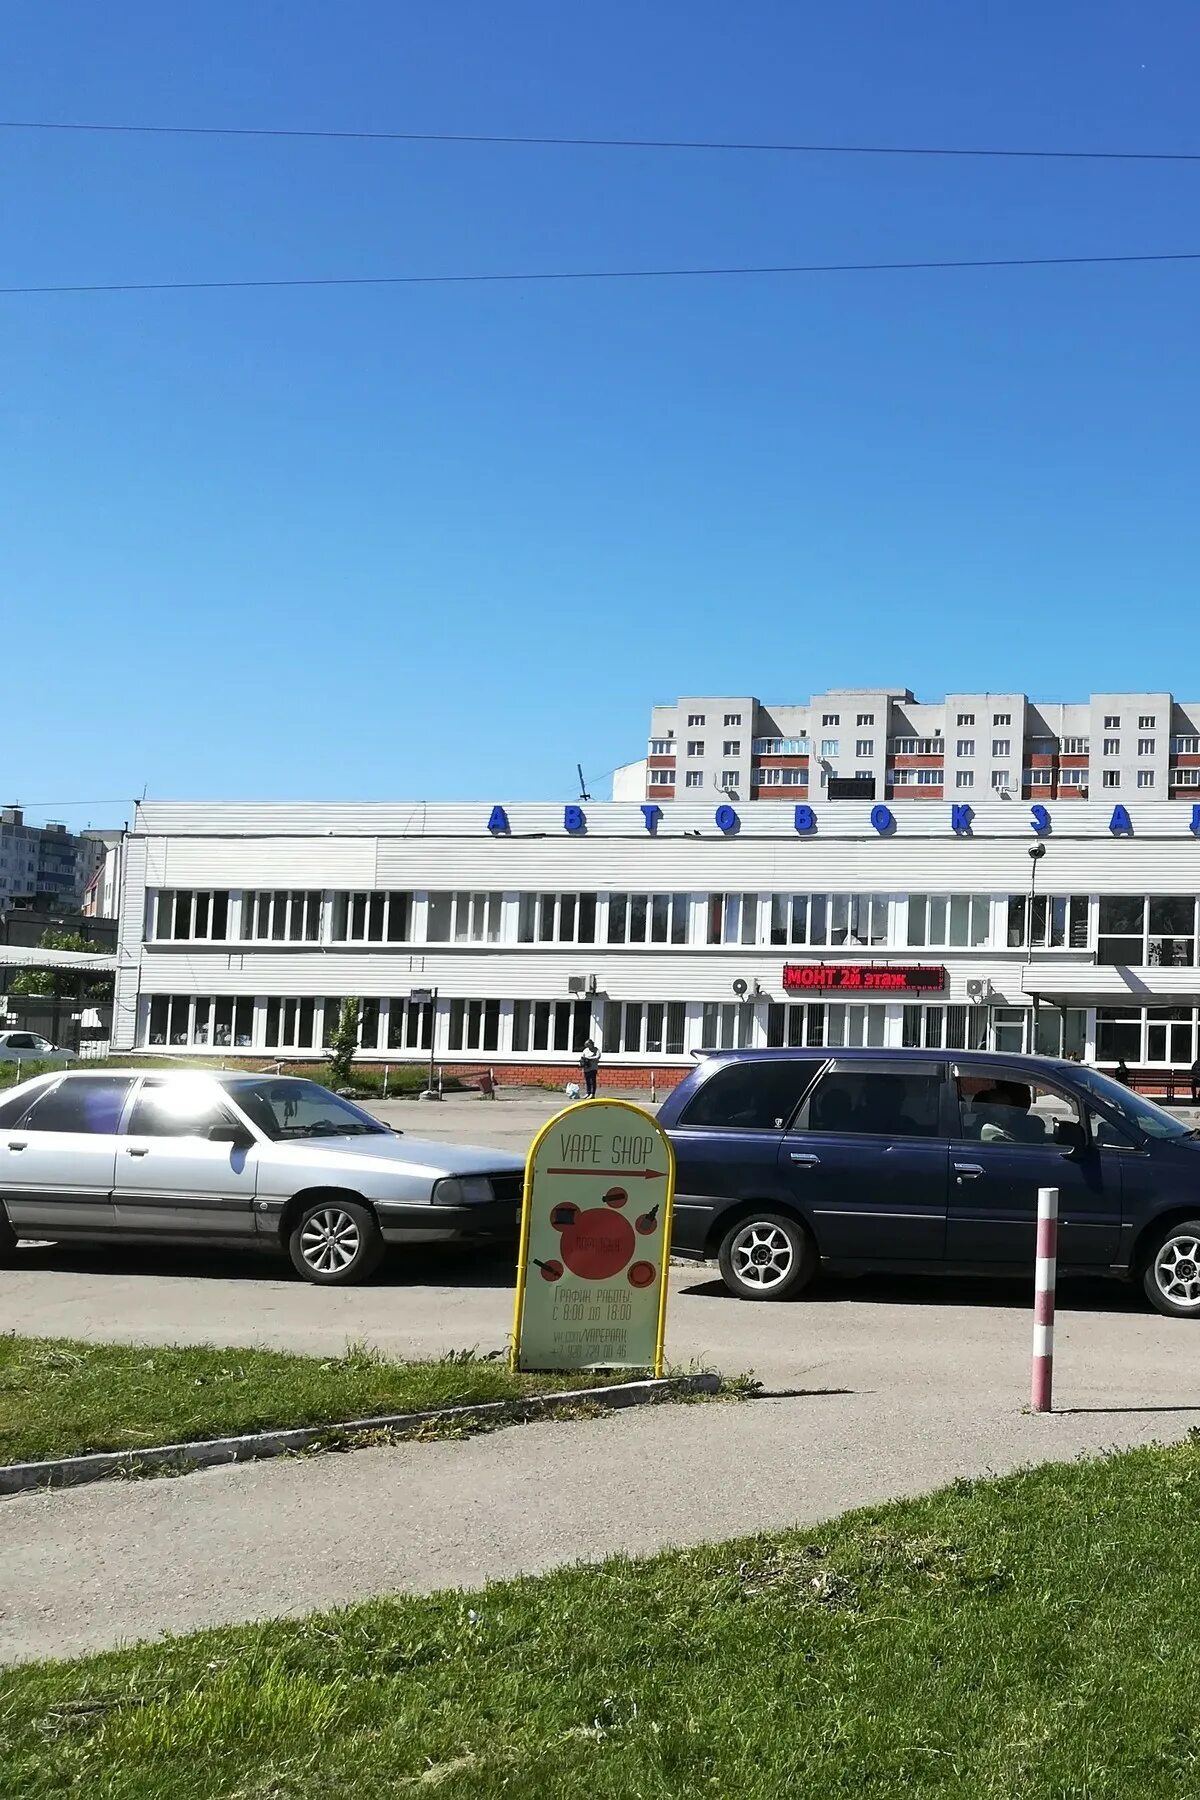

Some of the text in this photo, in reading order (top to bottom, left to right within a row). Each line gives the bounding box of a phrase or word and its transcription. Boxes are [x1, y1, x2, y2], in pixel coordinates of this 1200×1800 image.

[788, 968, 906, 986] МОНТ 2й этаж
[560, 1133, 654, 1165] VAPE SHOP
[563, 1303, 584, 1321] 8:00
[606, 1303, 632, 1321] 18:00
